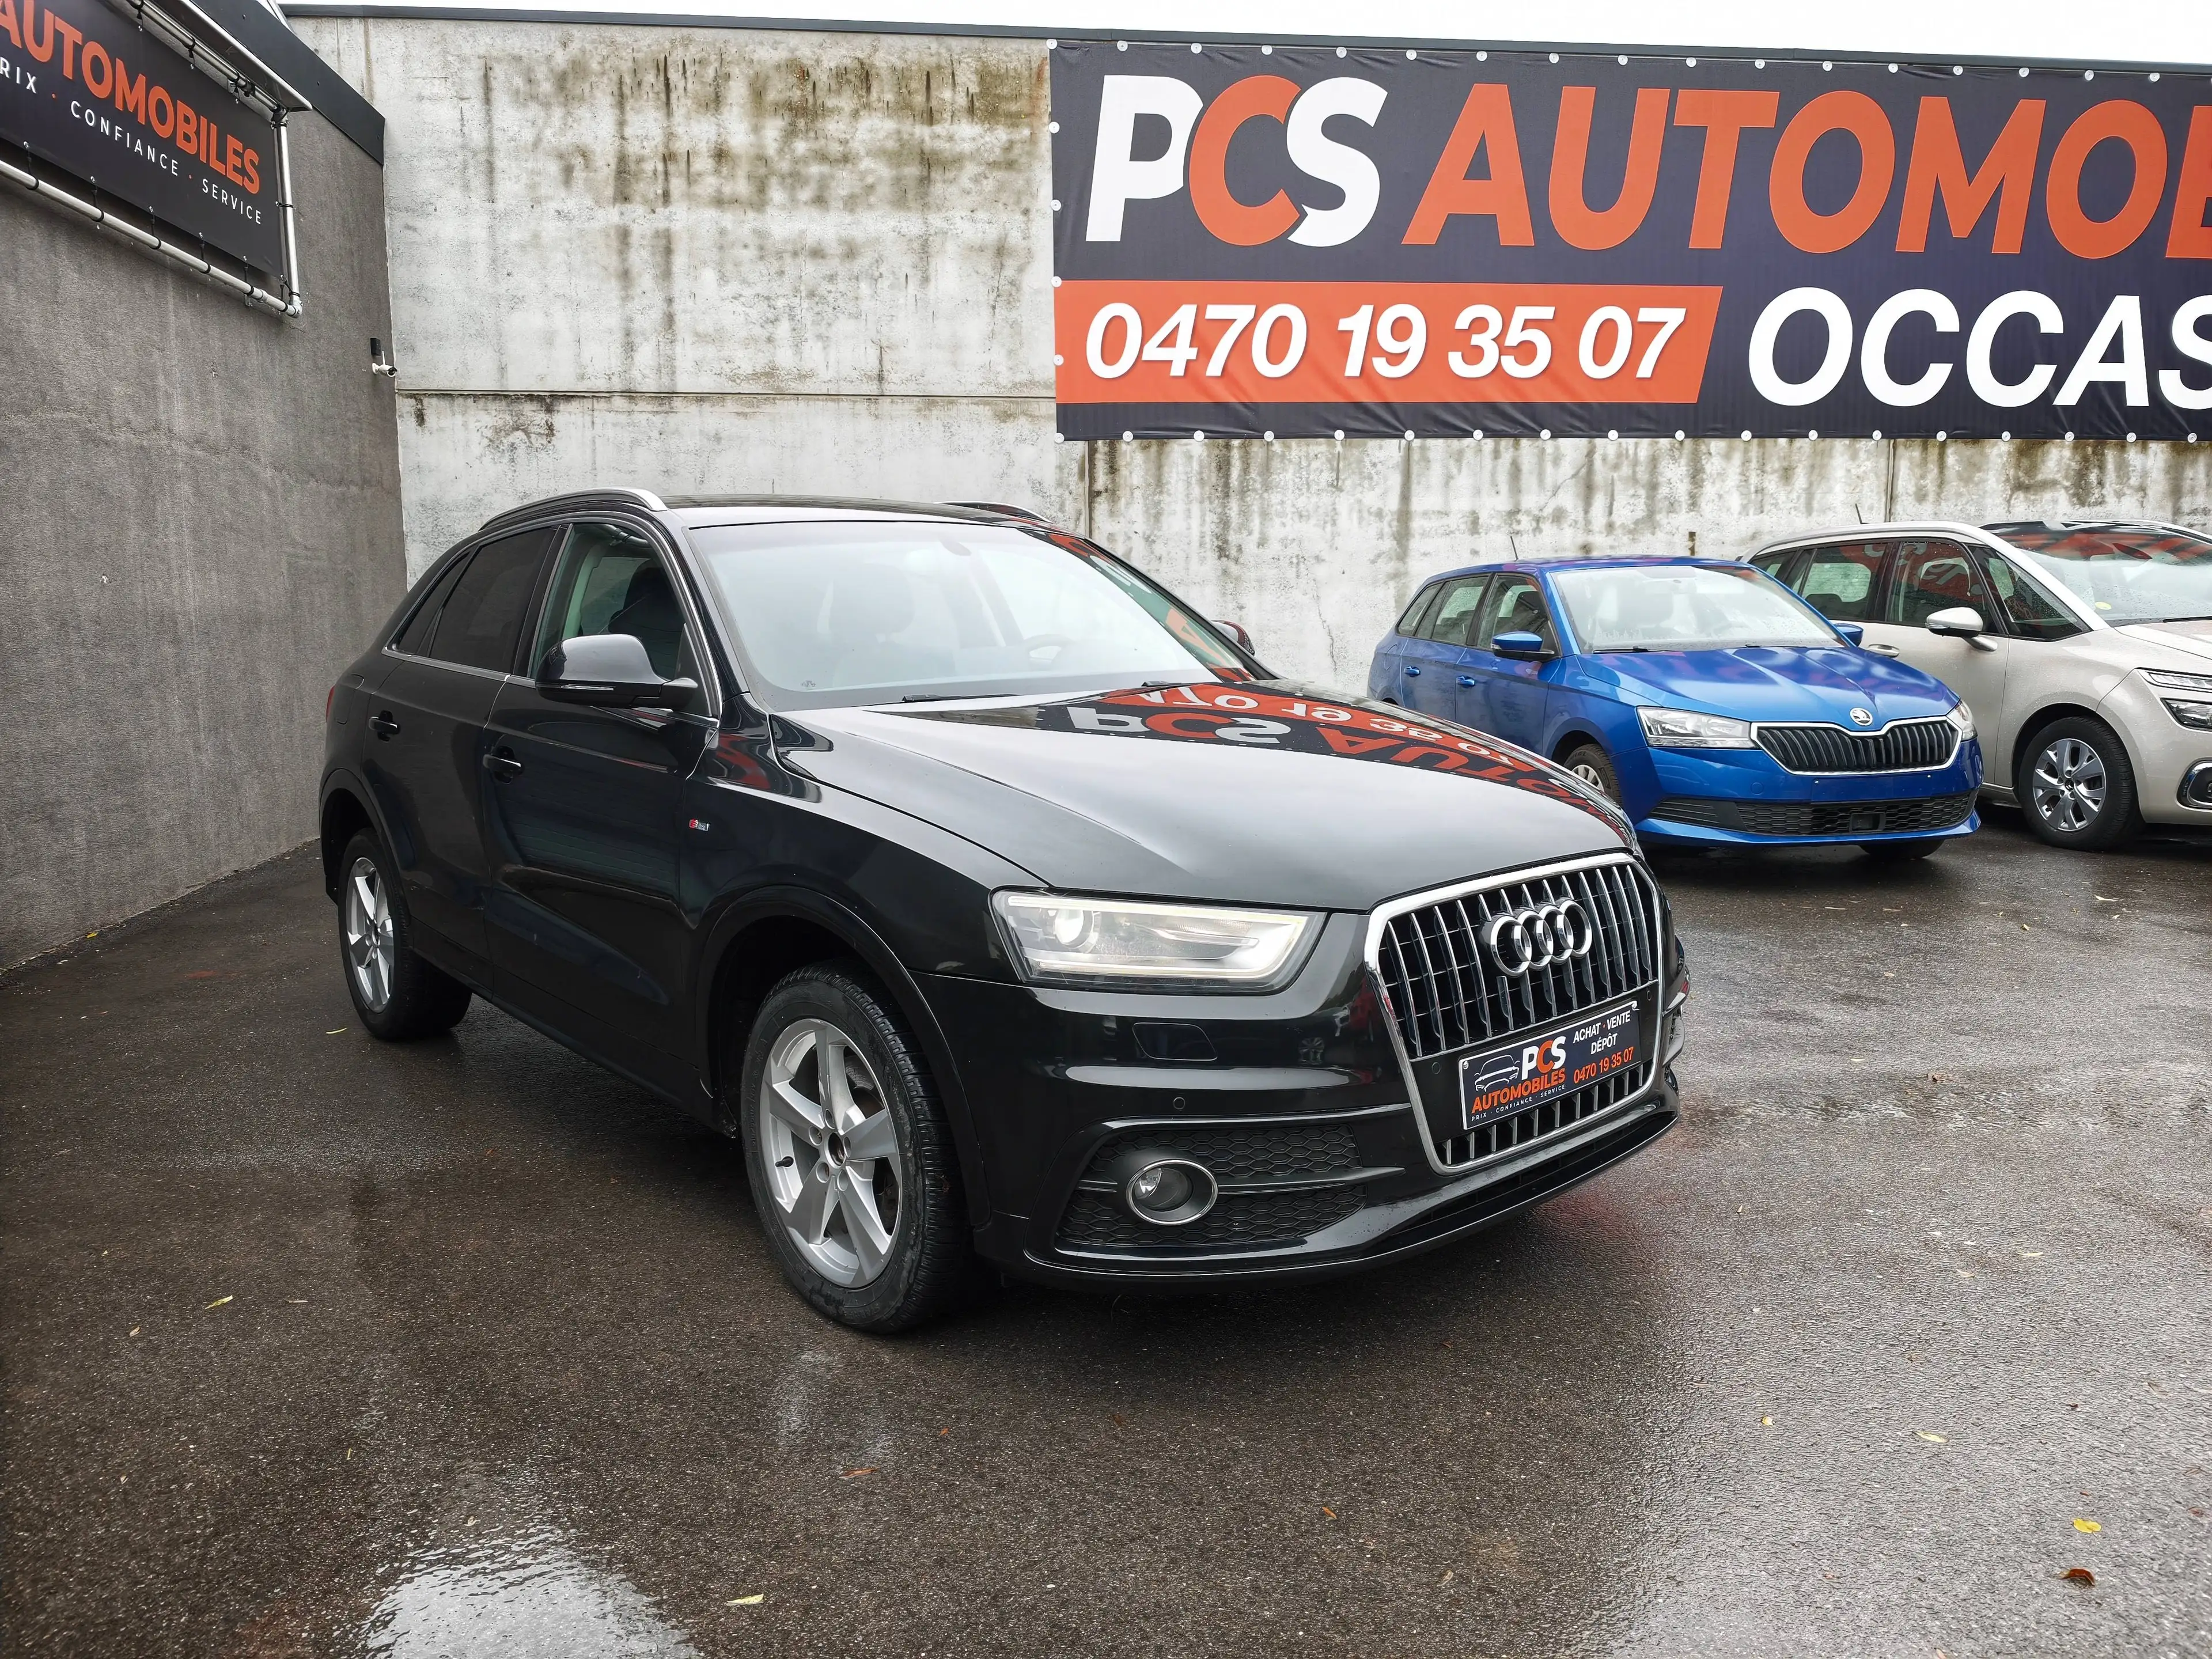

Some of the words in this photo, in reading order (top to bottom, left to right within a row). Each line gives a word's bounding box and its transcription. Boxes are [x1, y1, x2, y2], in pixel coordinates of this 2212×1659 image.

[71, 100, 178, 176] CONFIANCE
[202, 178, 262, 225] SERVICE
[1086, 75, 1388, 247] PCS
[1086, 302, 1307, 378] 0470
[1338, 304, 1427, 378] 19
[1448, 304, 1556, 378] 35
[1578, 306, 1687, 379] 07
[1573, 1022, 1601, 1043] ACHAT
[1607, 1010, 1631, 1030] VENTE
[1590, 1032, 1618, 1055] DÉPÔT
[1521, 1036, 1566, 1081] PCS
[1573, 1062, 1596, 1084] 0470
[1599, 1057, 1609, 1073] 19
[1611, 1051, 1622, 1069] 35
[1623, 1046, 1634, 1063] 07
[1471, 1068, 1566, 1114] AUTOMOBILES
[1471, 1112, 1487, 1122] PRIX
[1495, 1096, 1533, 1113] CONFIANCE
[1540, 1084, 1566, 1098] SERVICE
